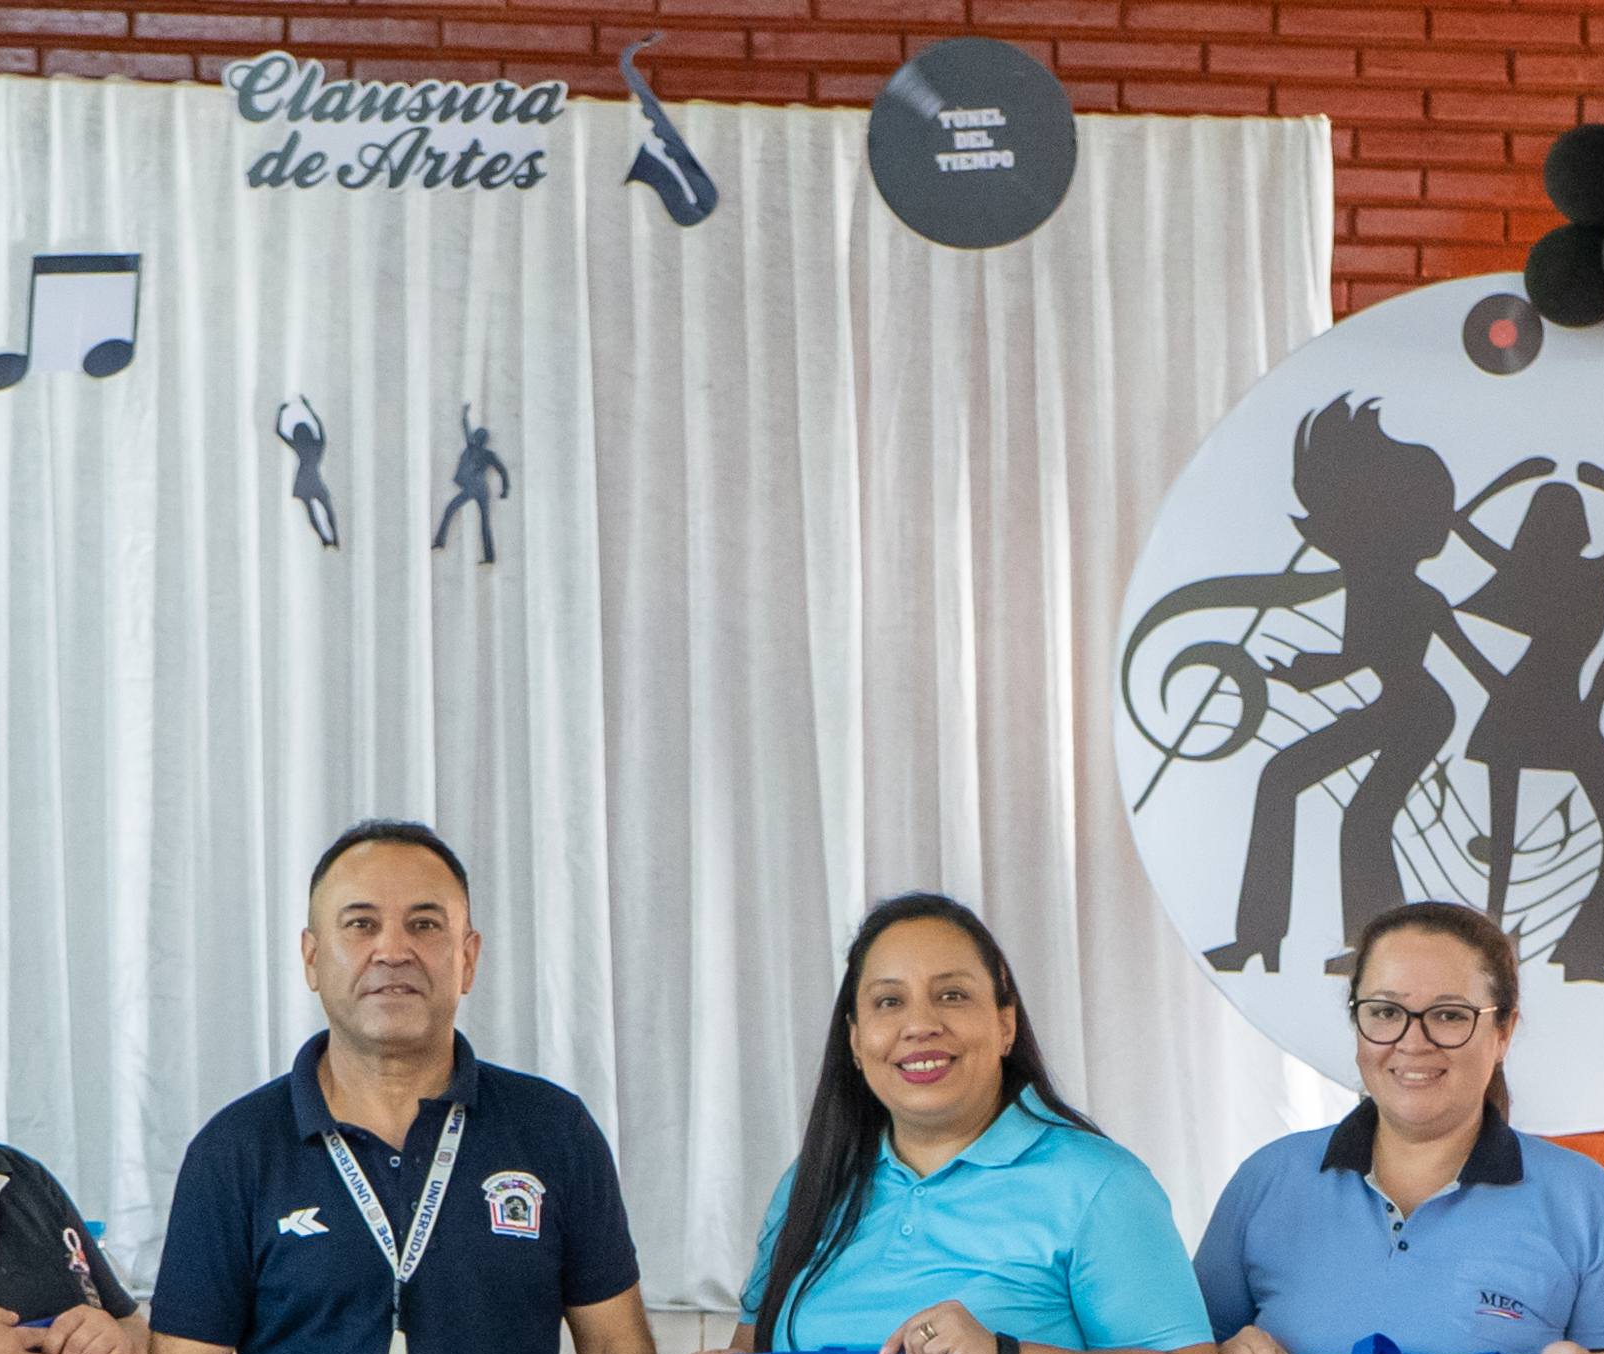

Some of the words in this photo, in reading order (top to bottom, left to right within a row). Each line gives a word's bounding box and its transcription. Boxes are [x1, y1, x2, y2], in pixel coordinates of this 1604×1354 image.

[229, 55, 566, 124] Clausura
[247, 129, 330, 189] de
[337, 126, 548, 190] Artes
[936, 149, 1014, 172] TIEMPO
[954, 130, 994, 150] DEL
[401, 1179, 444, 1274] UNIVERSIDAD
[1480, 1289, 1524, 1315] MEC
